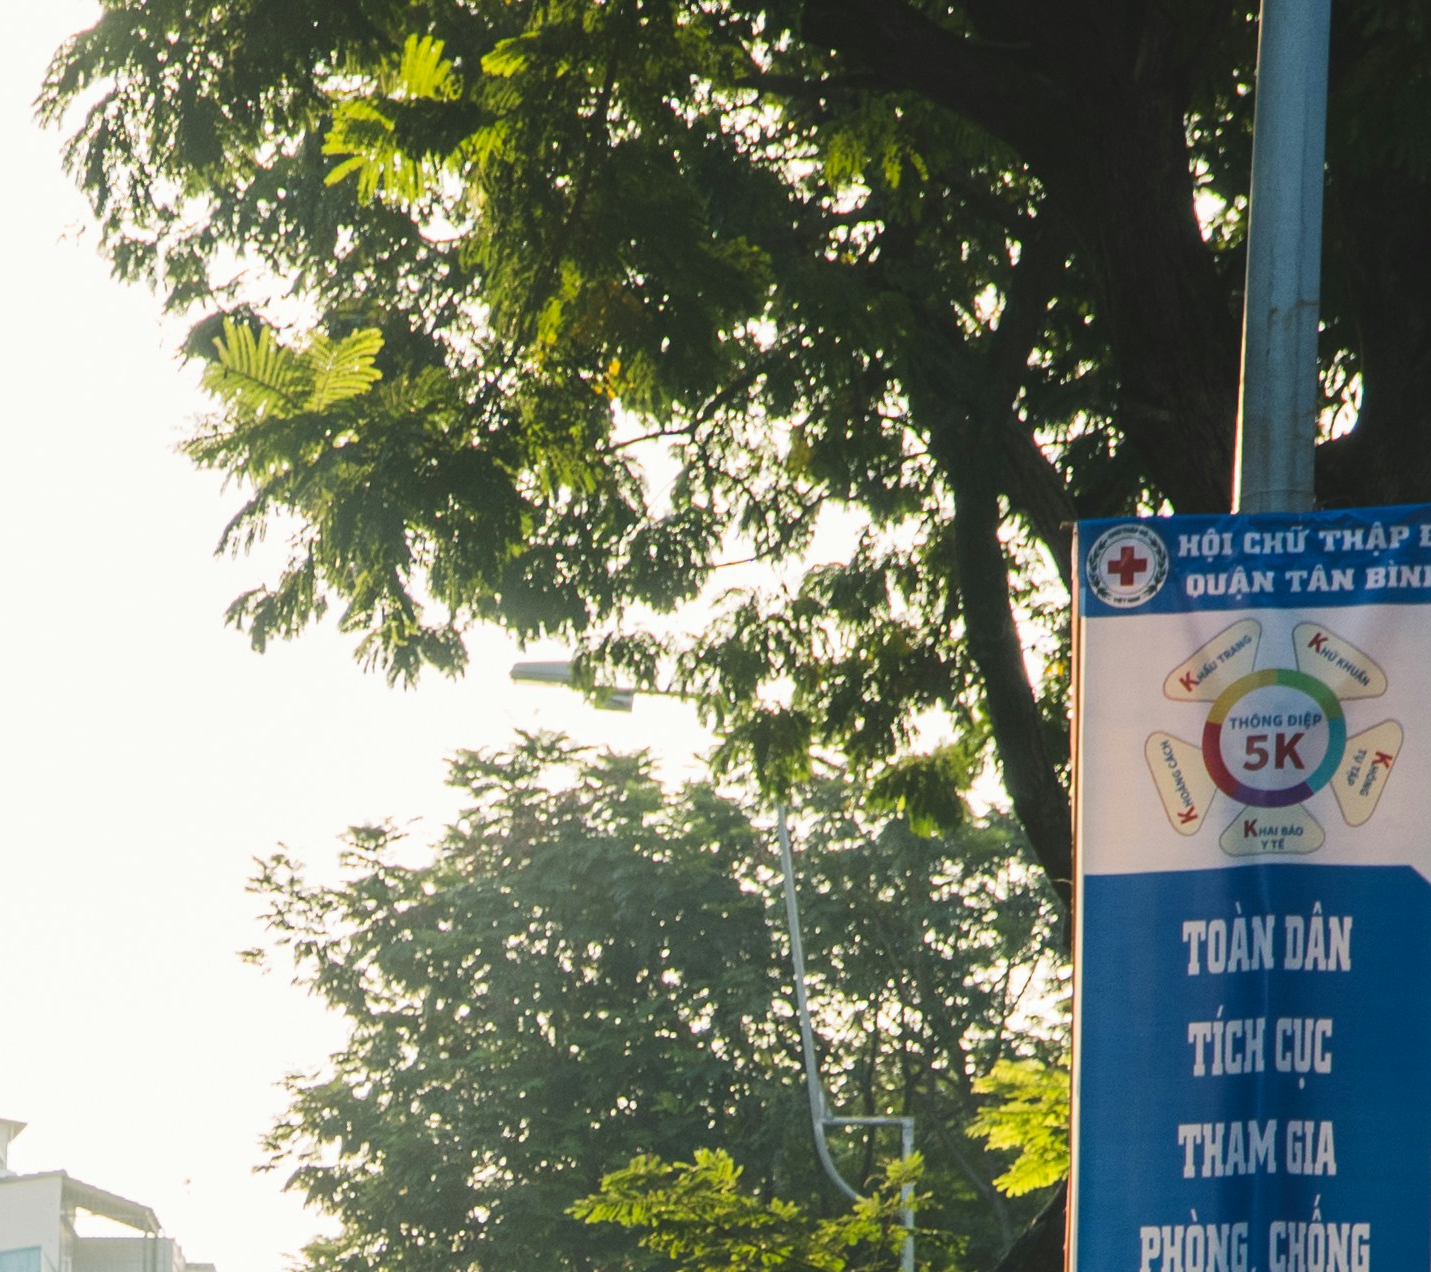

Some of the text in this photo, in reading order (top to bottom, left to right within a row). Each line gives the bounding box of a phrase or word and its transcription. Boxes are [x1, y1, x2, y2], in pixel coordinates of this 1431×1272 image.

[1178, 529, 1233, 562] HỘI
[1243, 522, 1307, 555] CHỮ
[1318, 521, 1410, 557] THẬP
[1186, 567, 1275, 599] QUẬN
[1286, 566, 1354, 592] TÂN
[1216, 635, 1252, 662] TRANG
[1307, 632, 1371, 687] KHỬ KHUẨN
[1229, 711, 1323, 730] THÔNG ĐIỆP
[1242, 732, 1305, 772] 5K
[1244, 819, 1278, 839] KHAI
[1261, 838, 1285, 850] Y TẾ
[1183, 901, 1353, 975] TOÀN DÂN
[1188, 1001, 1333, 1089] TÍCH CỤC
[1177, 1120, 1337, 1178] THAM GIA
